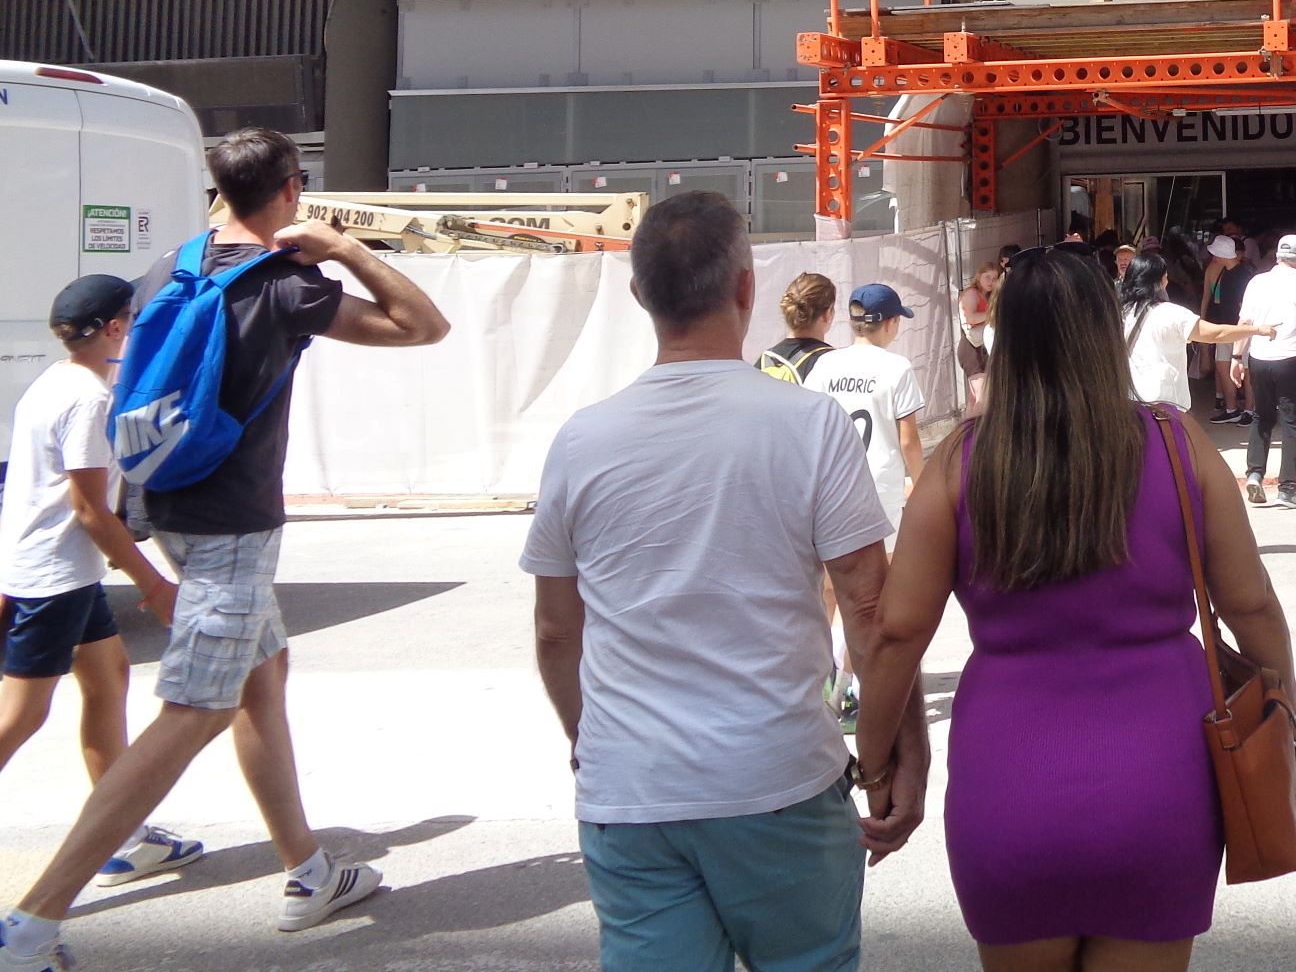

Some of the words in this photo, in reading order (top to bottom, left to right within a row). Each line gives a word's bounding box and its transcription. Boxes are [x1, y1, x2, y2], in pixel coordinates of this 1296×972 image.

[307, 204, 327, 221] 902
[353, 210, 374, 227] 200
[114, 389, 185, 460] NIKE
